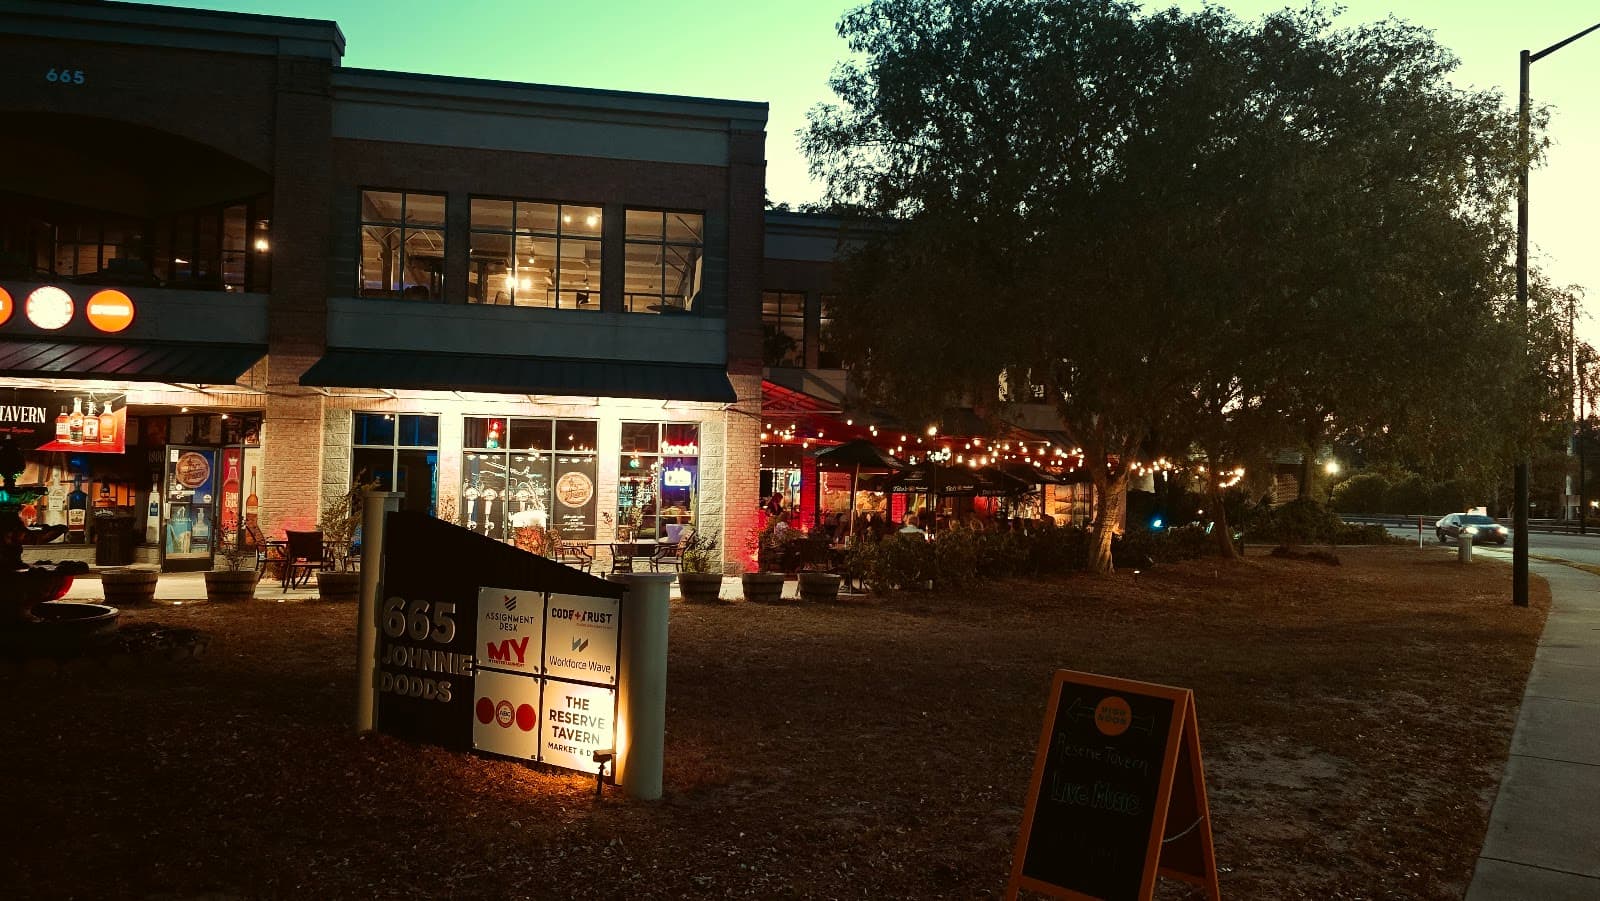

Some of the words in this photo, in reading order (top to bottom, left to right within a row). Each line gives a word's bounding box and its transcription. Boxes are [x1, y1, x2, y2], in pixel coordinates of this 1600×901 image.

[45, 68, 85, 85] 665
[0, 405, 47, 424] TAVERN
[382, 595, 456, 644] 665
[486, 612, 534, 625] ASSIGNMENT
[499, 622, 518, 632] DESK
[486, 636, 530, 664] MY
[381, 643, 473, 677] JOHNNIE
[549, 655, 587, 670] Workforce
[588, 660, 611, 673] Wave
[380, 671, 452, 703] DODDS
[565, 695, 590, 711] THE
[549, 708, 606, 730] RESERVE
[551, 725, 600, 745] TAVERN
[547, 741, 577, 754] MARKET
